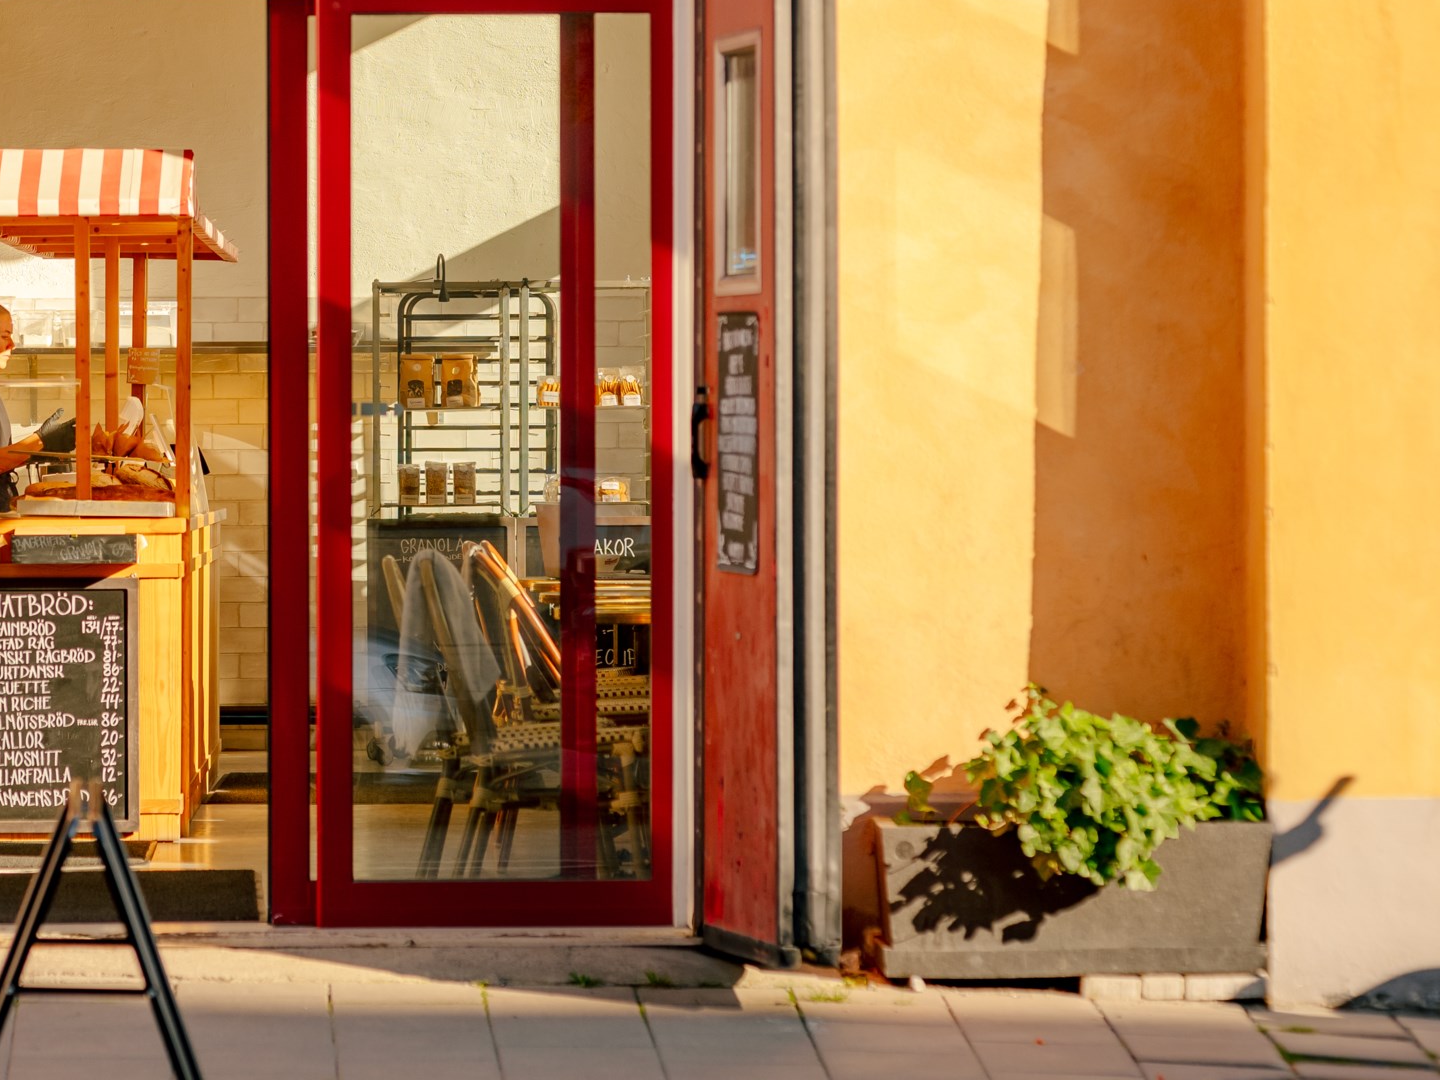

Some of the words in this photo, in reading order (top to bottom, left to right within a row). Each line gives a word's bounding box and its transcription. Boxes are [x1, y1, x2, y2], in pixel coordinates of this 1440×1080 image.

[400, 538, 464, 555] GRANOLA
[594, 537, 636, 557] AKOR
[11, 696, 51, 712] RICHE
[54, 789, 90, 807] BRD
